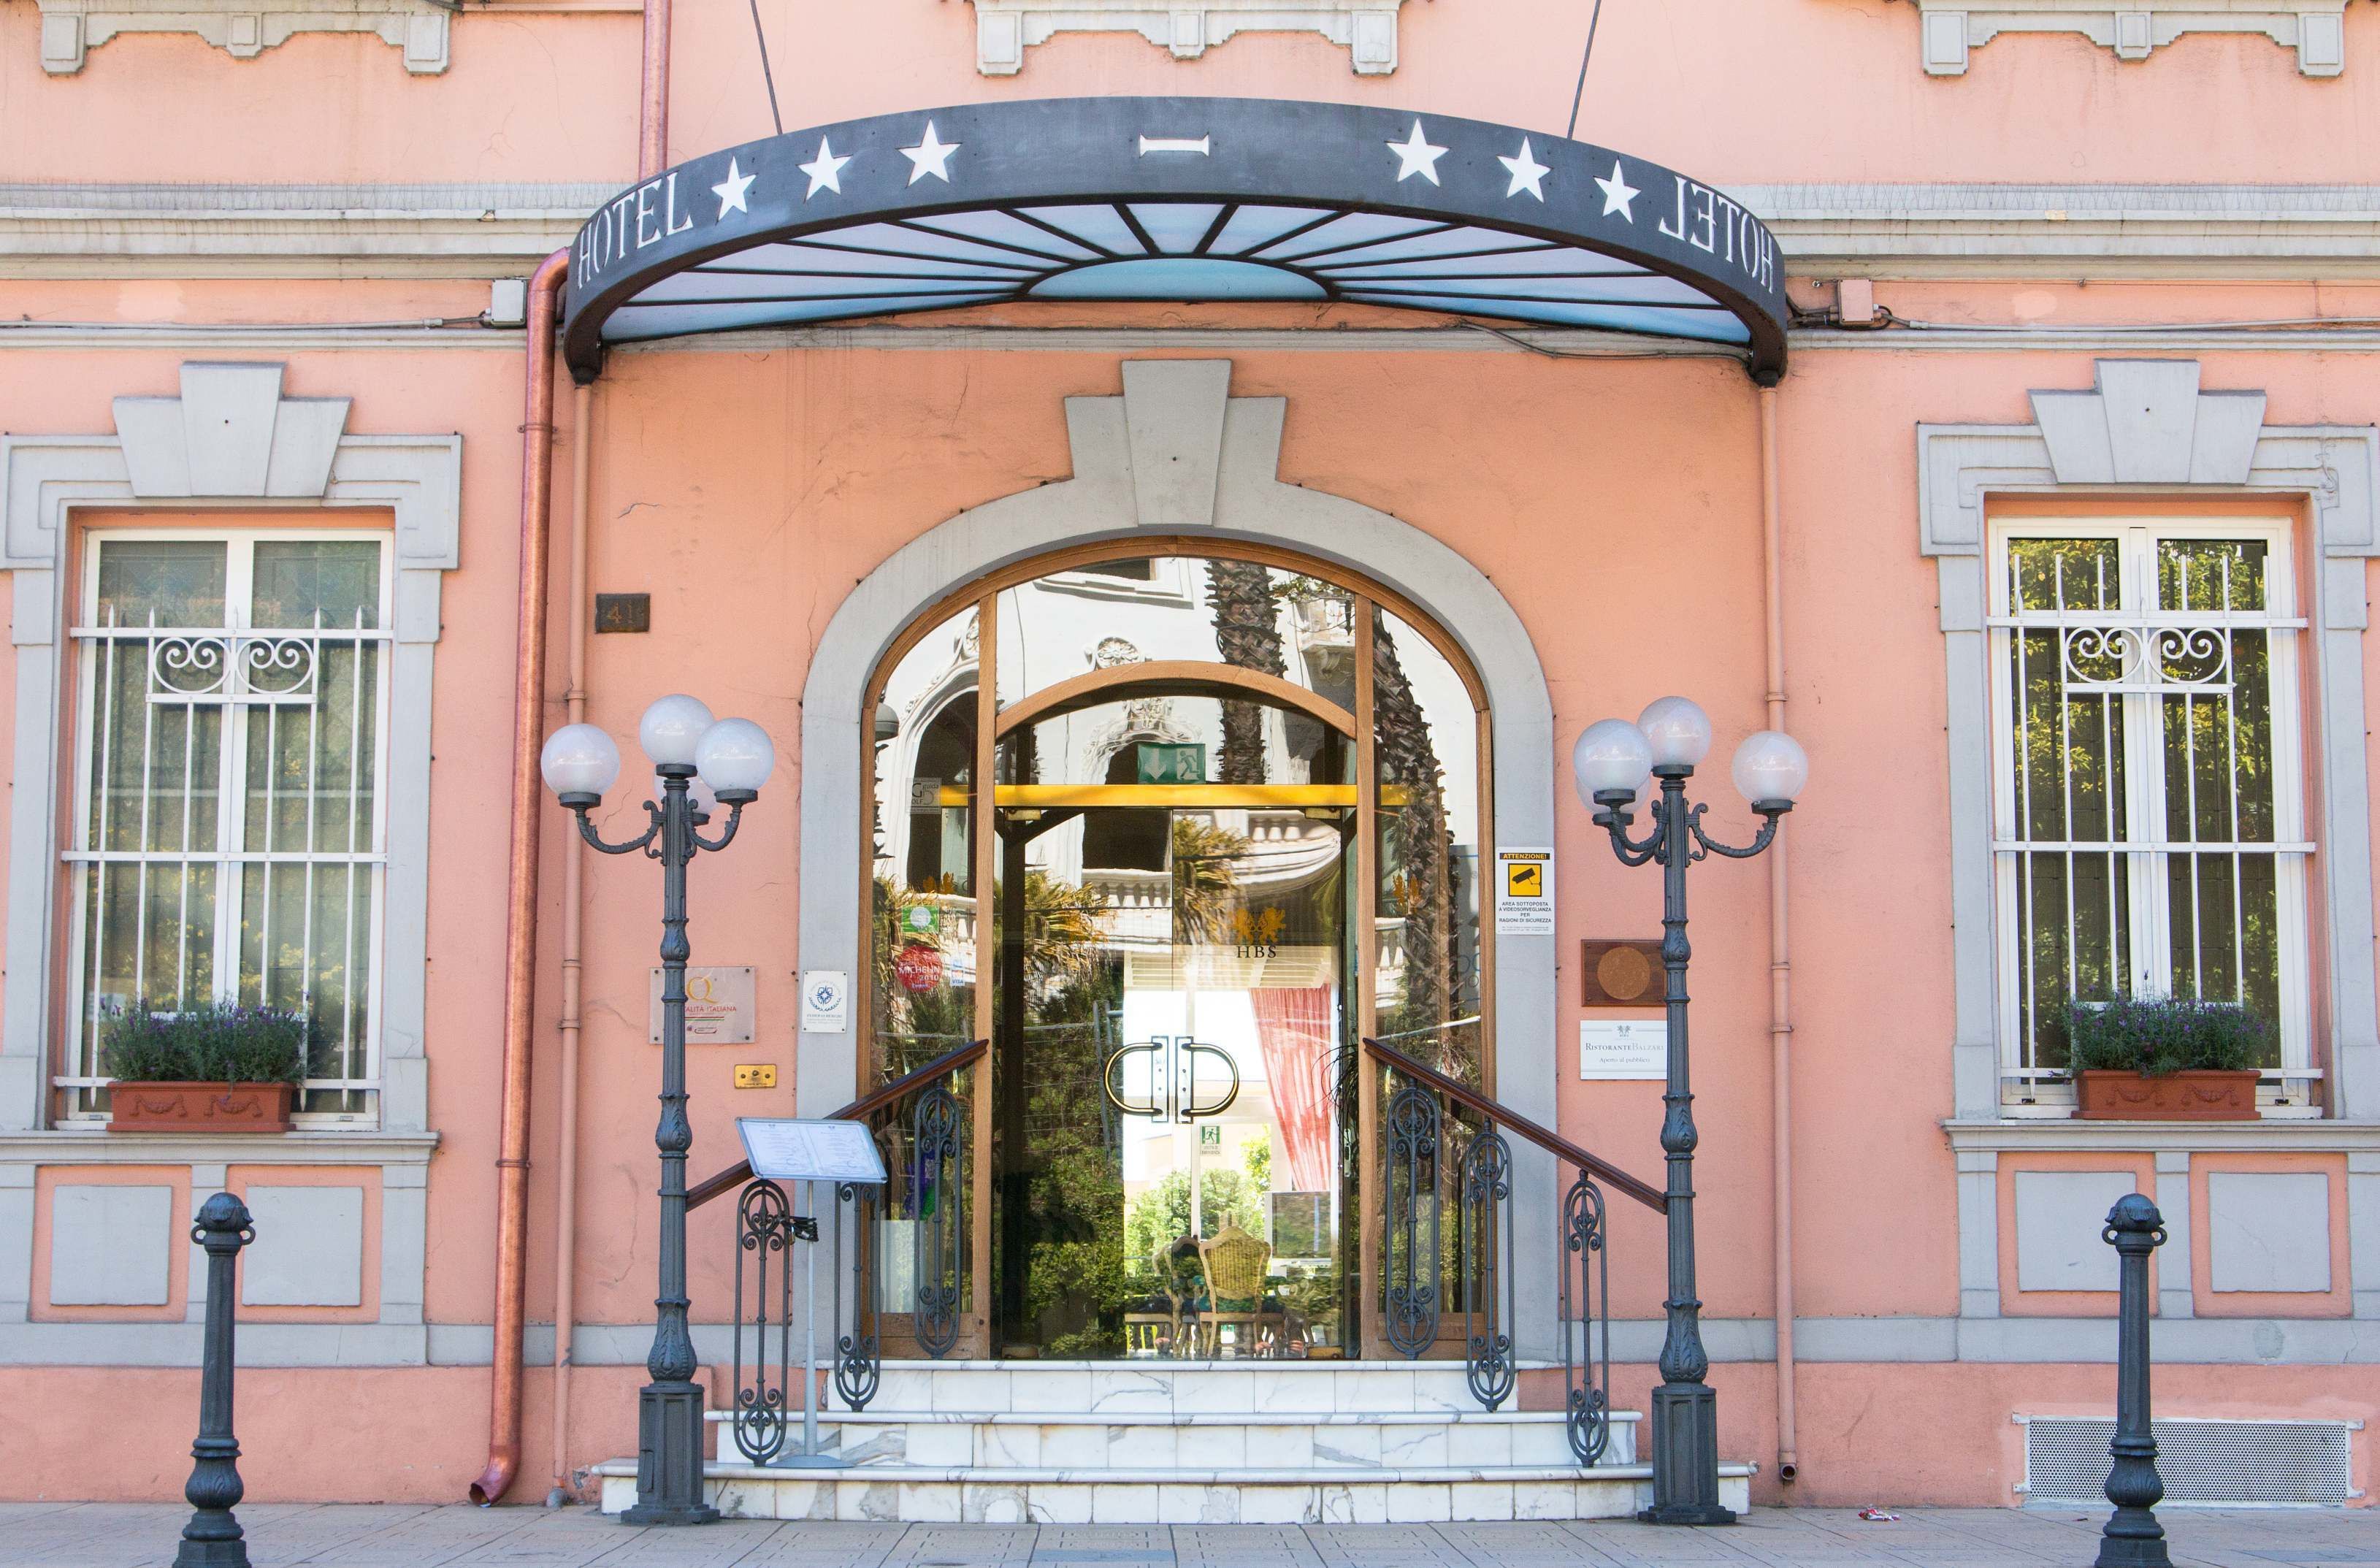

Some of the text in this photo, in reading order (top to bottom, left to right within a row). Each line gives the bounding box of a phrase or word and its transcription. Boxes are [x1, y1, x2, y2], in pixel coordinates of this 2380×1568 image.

[578, 171, 694, 289] HOTEL
[1236, 946, 1277, 958] HBS
[898, 966, 940, 974] MICHELIN
